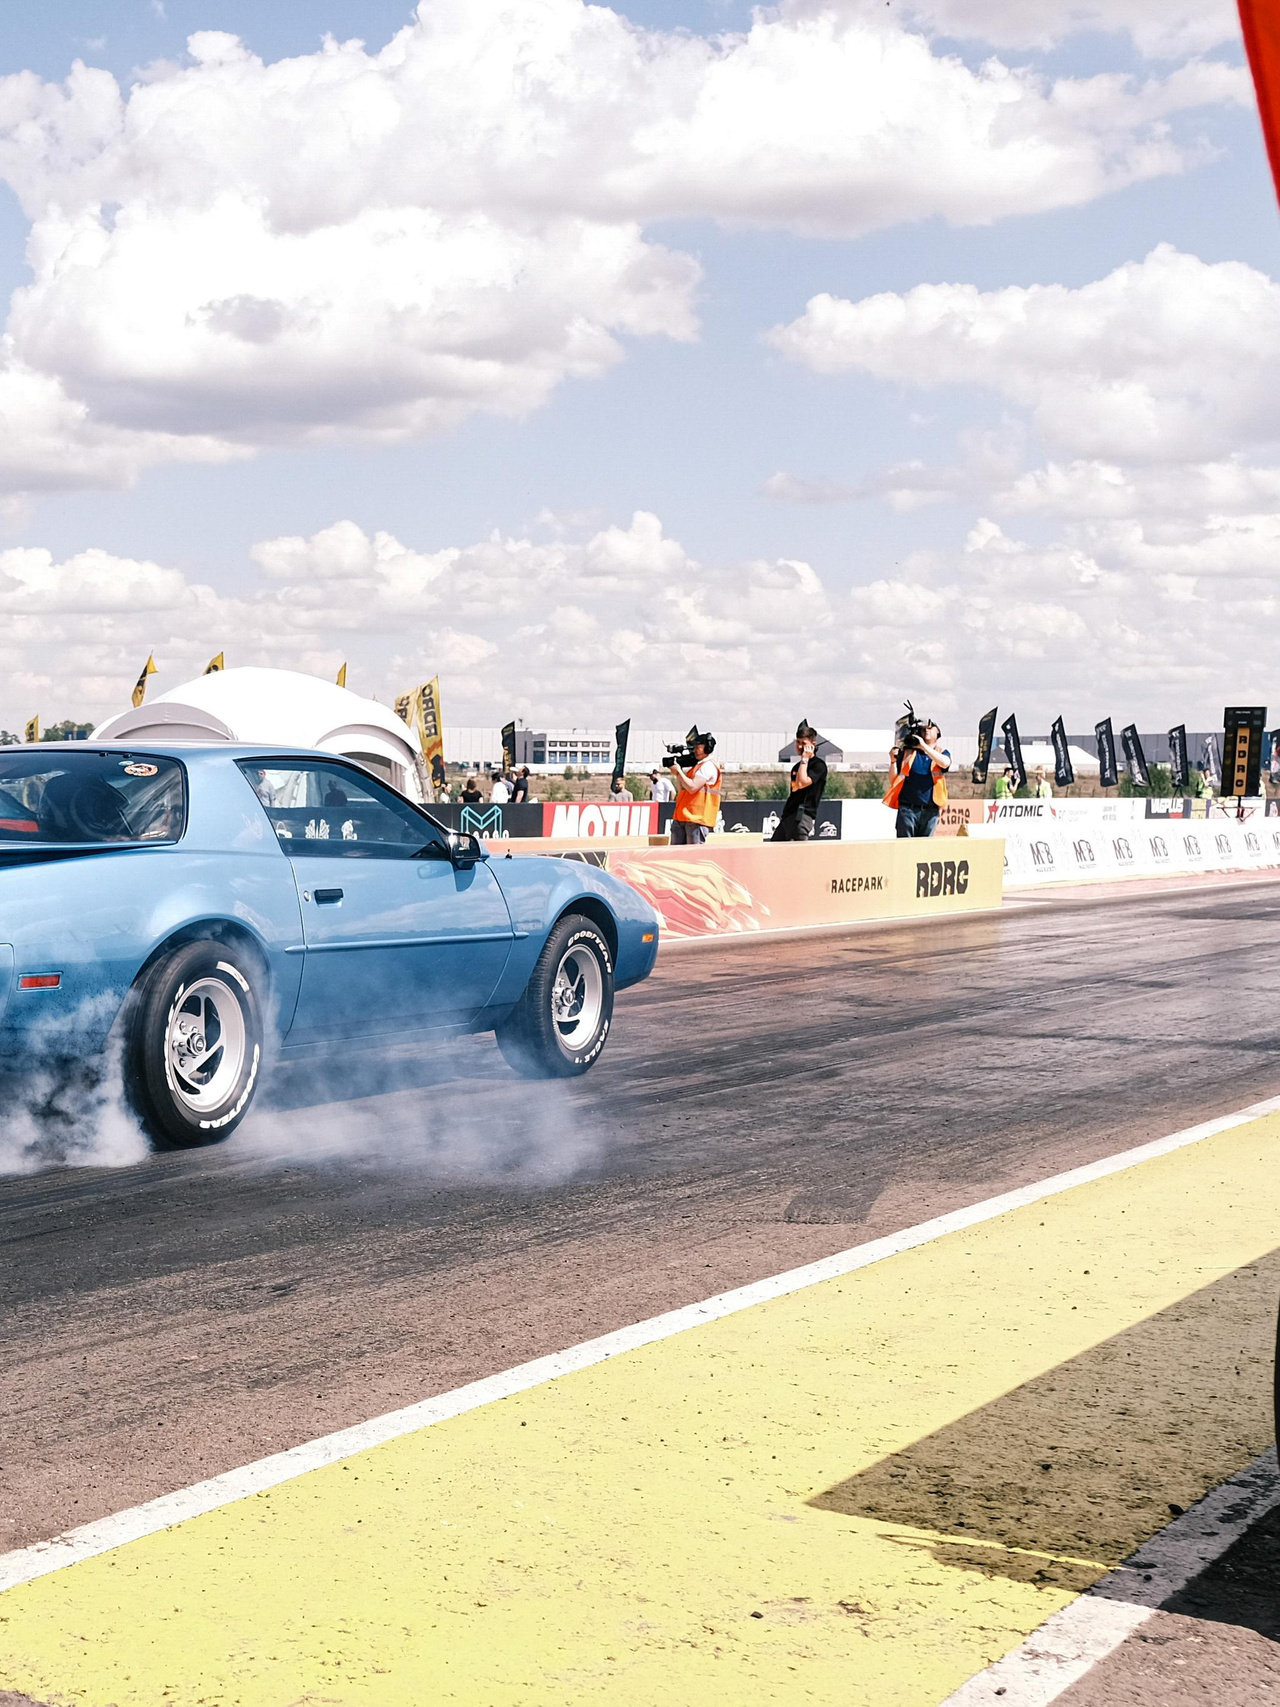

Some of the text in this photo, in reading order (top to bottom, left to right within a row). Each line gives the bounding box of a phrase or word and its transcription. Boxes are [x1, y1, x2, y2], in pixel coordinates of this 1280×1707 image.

[999, 804, 1044, 818] ATOMIC
[831, 876, 884, 894] RACEPARK
[916, 860, 969, 898] RDRC
